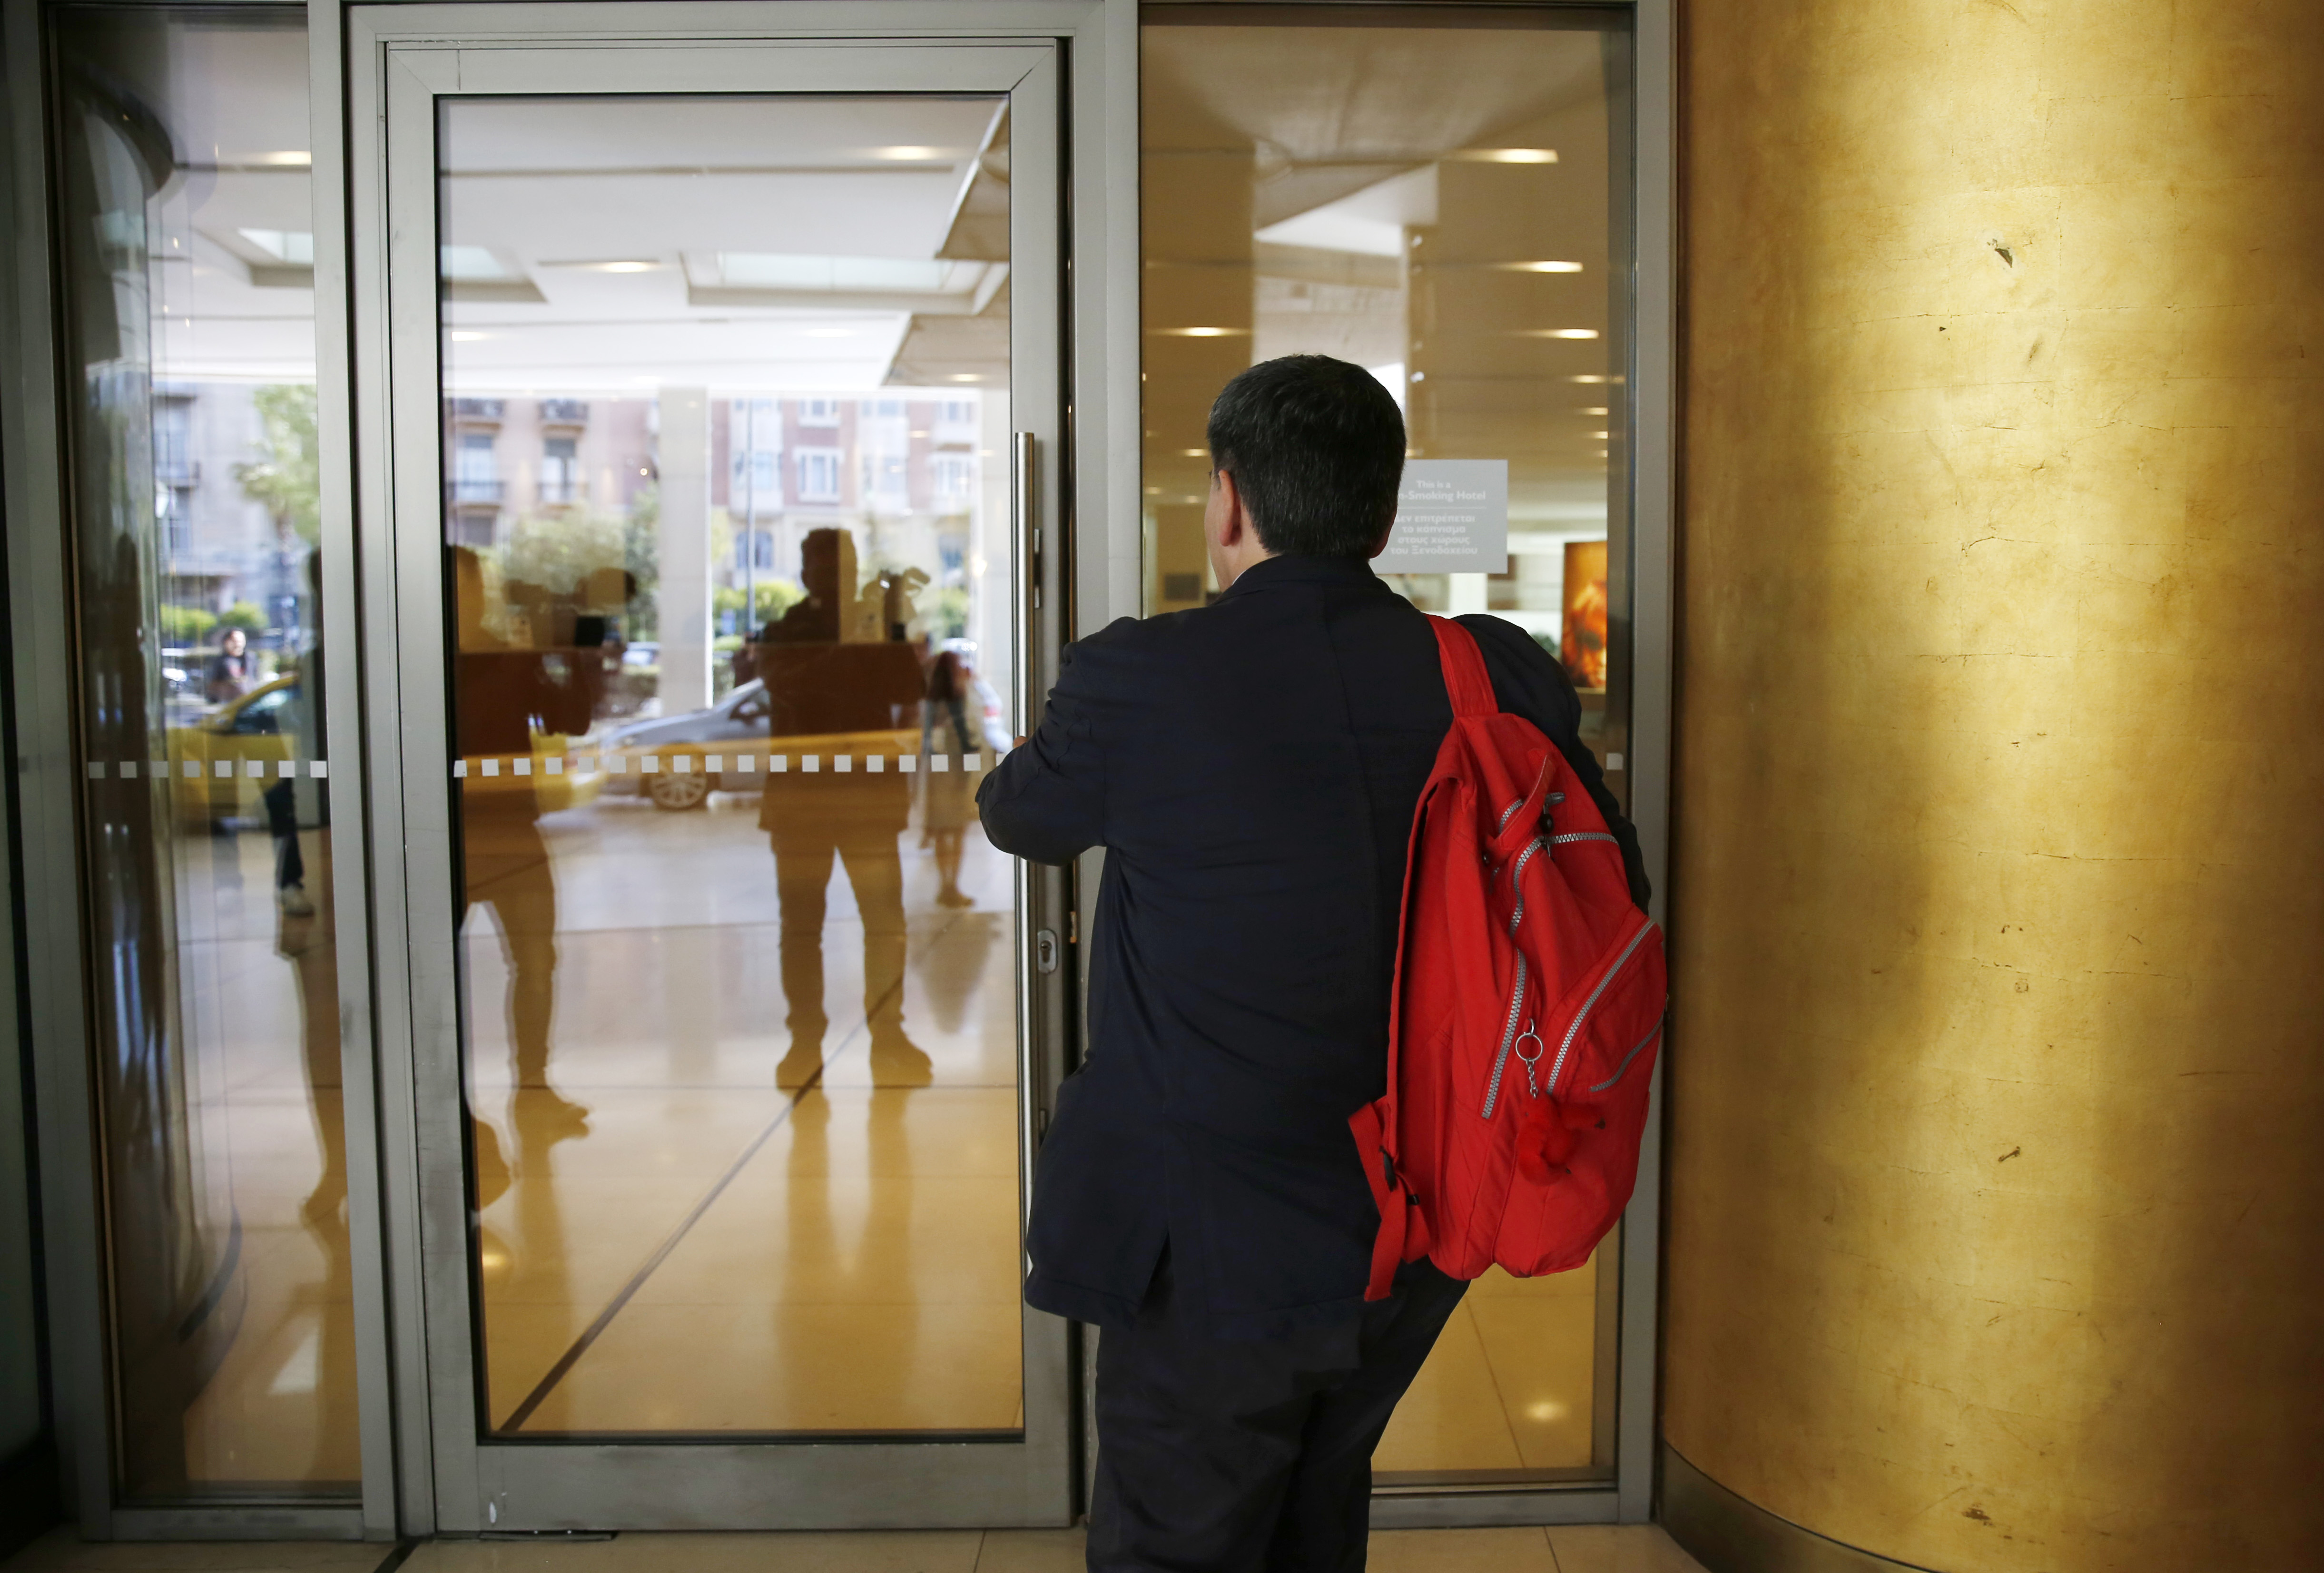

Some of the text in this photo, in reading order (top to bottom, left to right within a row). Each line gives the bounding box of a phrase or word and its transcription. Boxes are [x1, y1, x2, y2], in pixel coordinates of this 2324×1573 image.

[1416, 480, 1435, 489] This
[1437, 480, 1444, 489] is
[1398, 491, 1486, 502] n-Smoking Hotel
[1397, 537, 1428, 545] στους
